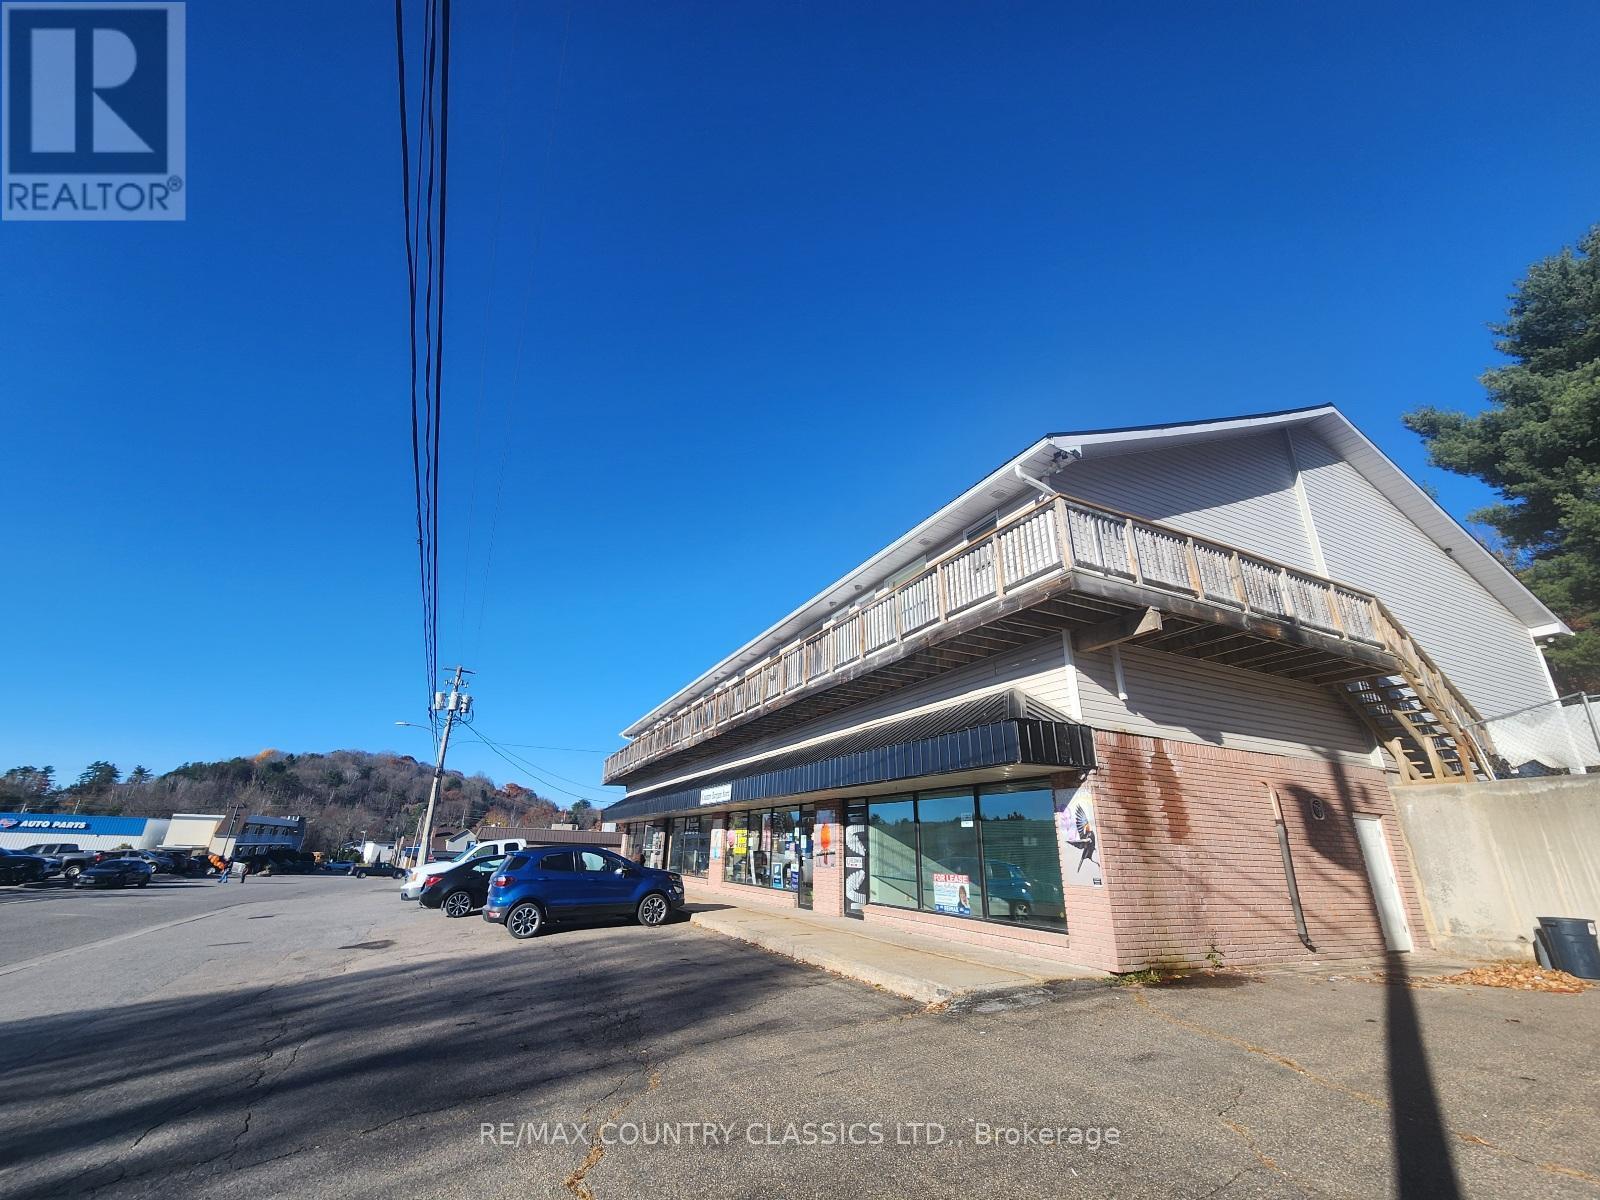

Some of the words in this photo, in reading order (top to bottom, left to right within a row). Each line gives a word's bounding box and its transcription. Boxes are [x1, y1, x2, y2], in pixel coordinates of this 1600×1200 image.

[19, 820, 51, 828] AUTO
[52, 821, 87, 829] PARTS
[934, 873, 946, 882] FOR
[946, 874, 969, 884] LEASE
